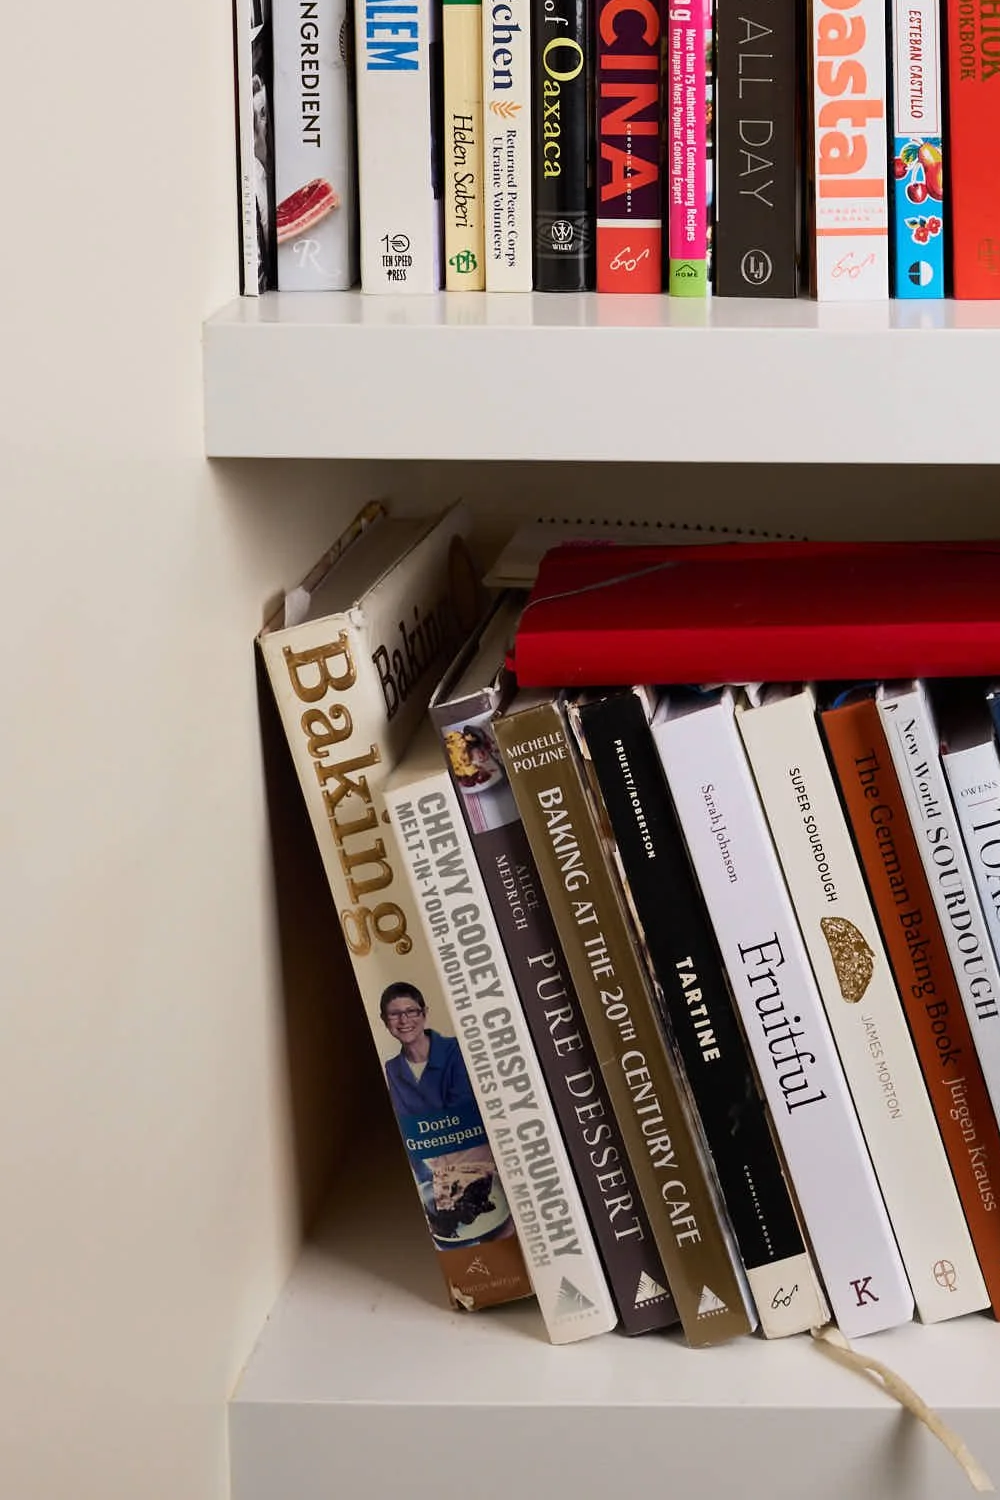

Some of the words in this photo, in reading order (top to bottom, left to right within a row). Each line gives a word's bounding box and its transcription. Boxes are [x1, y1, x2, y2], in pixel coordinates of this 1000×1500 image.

[544, 2, 569, 26] of
[738, 17, 774, 99] ALL
[543, 37, 584, 180] Oaxaca
[506, 130, 518, 188] Returned
[739, 120, 774, 207] DAY
[505, 230, 520, 268] Corps
[507, 192, 519, 227] Peace
[901, 717, 919, 757] New
[281, 627, 414, 957] Baking
[912, 762, 941, 819] World
[537, 786, 591, 893] BAKING
[789, 767, 812, 812] SUPER
[803, 812, 839, 903] SOURDOUGH
[571, 899, 599, 926] AT
[855, 747, 880, 792] The
[870, 795, 911, 906] German
[900, 909, 936, 999] Baking
[925, 1000, 960, 1067] Book
[926, 827, 999, 1021] SOURDOUGH
[584, 933, 616, 981] THE
[416, 791, 473, 897] CHEWY
[449, 903, 505, 1001] GOOEY
[482, 1007, 539, 1113] CRISPY
[516, 1118, 582, 1258] CRUNCHY
[600, 986, 637, 1044] 20TH
[675, 955, 721, 1063] TARTINE
[737, 931, 828, 1115] Fruitful
[417, 1113, 461, 1134] Dorie
[527, 947, 584, 1057] PURE
[564, 1067, 645, 1242] DESSERT
[621, 1049, 679, 1170] CENTURY
[406, 1124, 483, 1152] Greenspan
[942, 1075, 978, 1143] Jürgen
[968, 1145, 997, 1213] Krauss
[661, 1180, 702, 1249] CAFE
